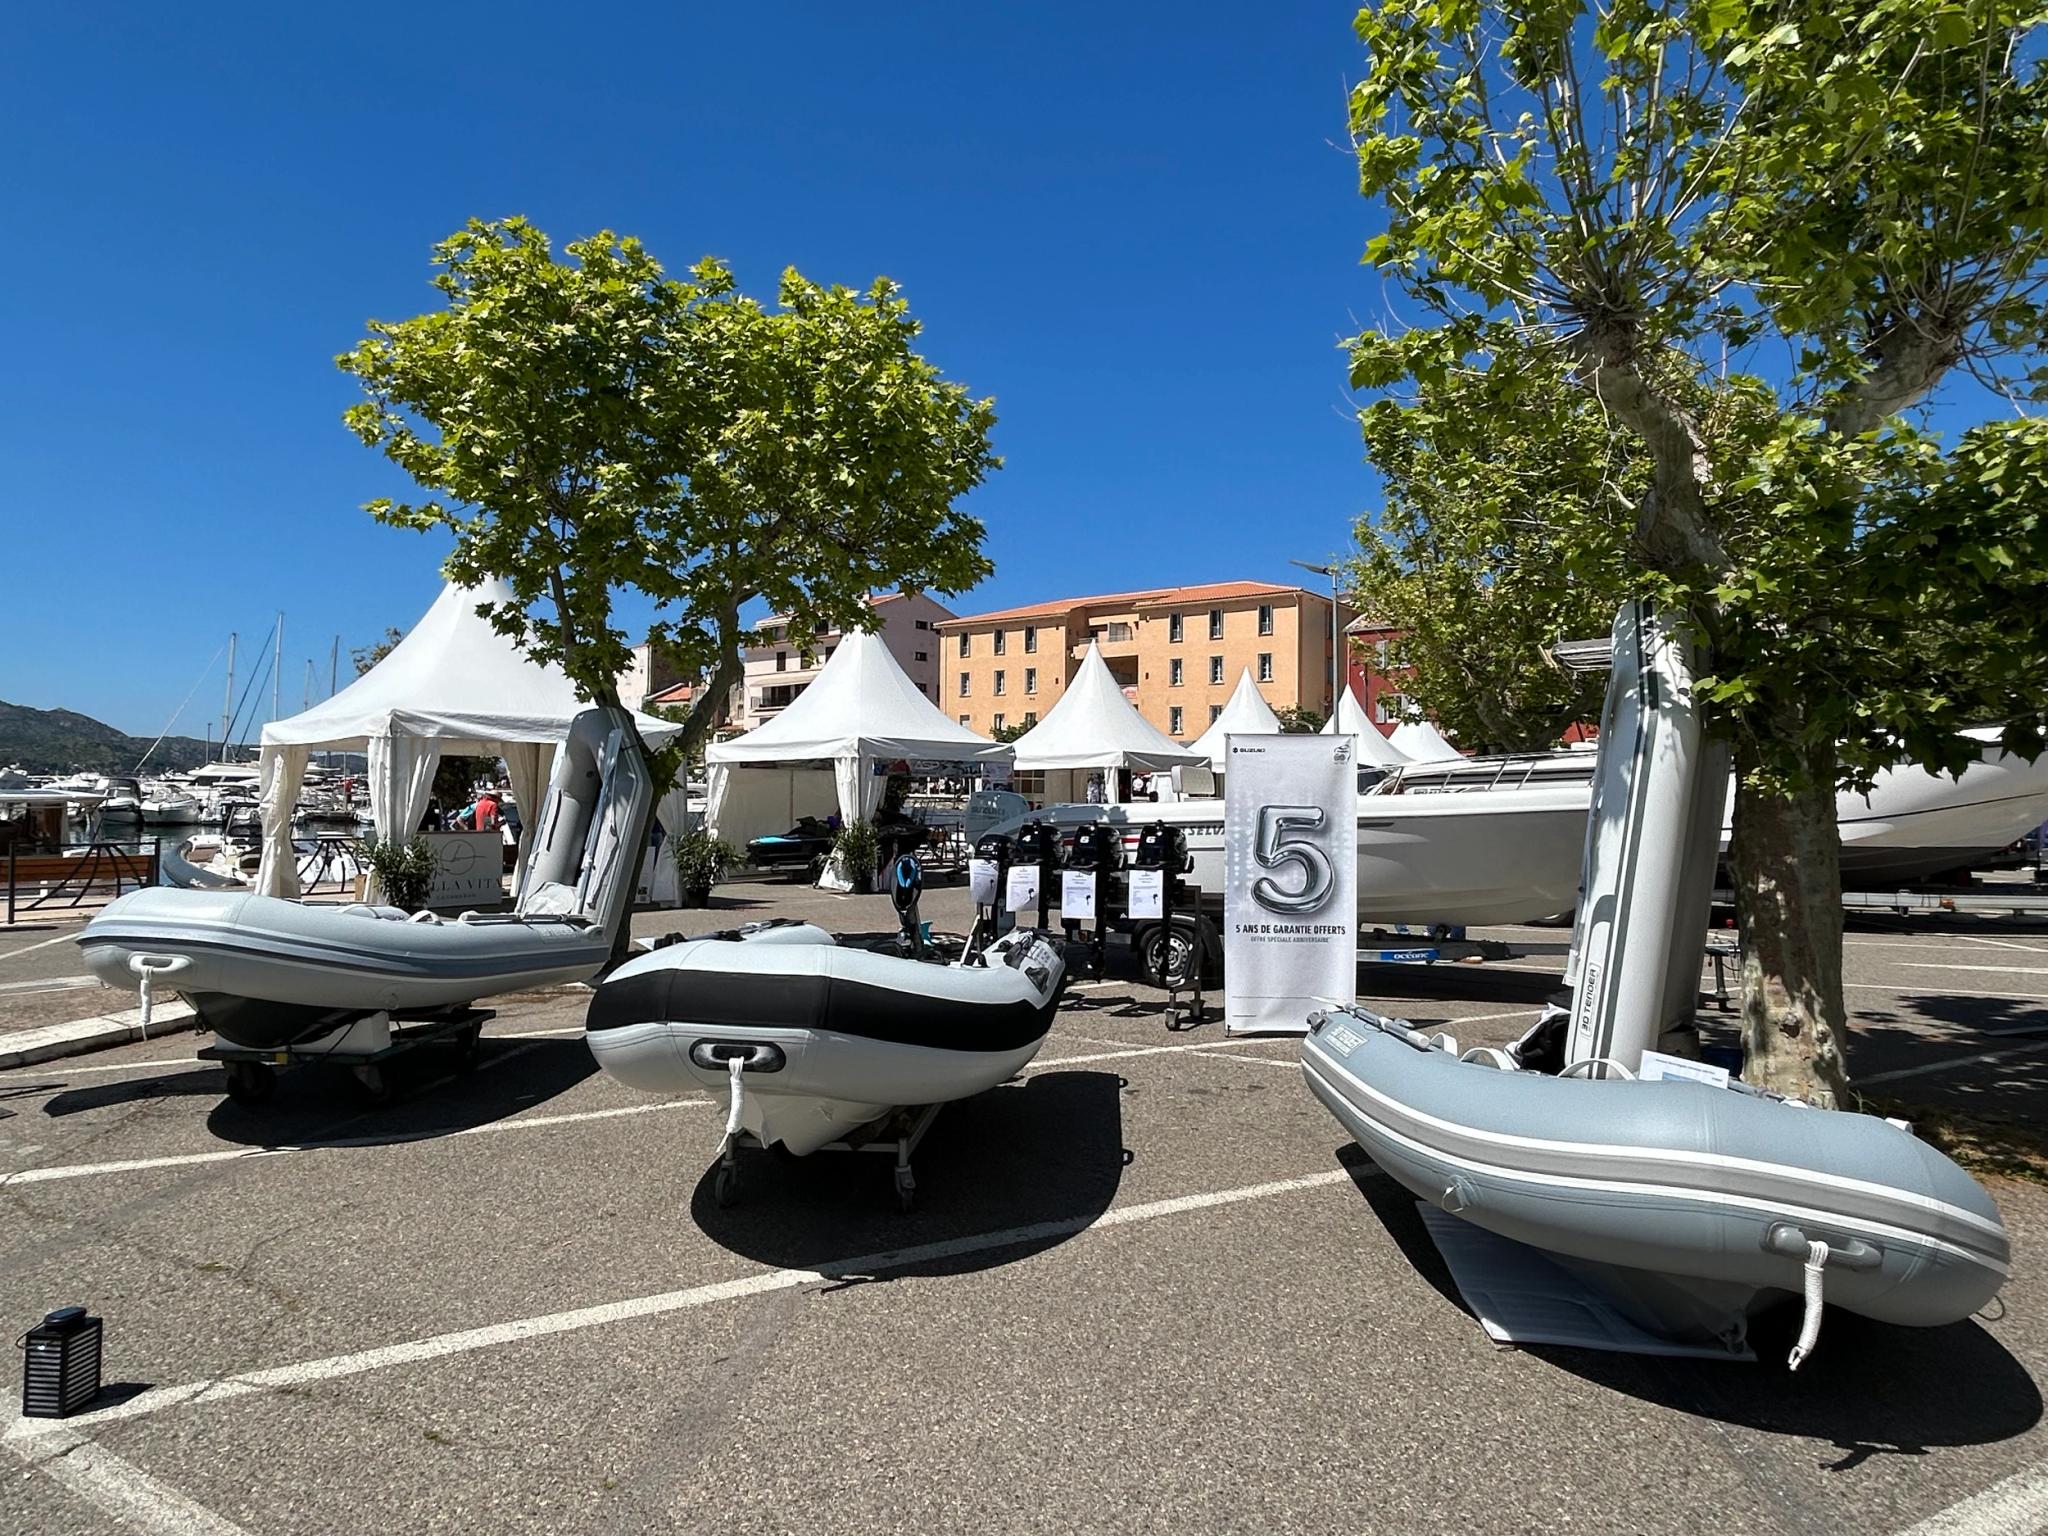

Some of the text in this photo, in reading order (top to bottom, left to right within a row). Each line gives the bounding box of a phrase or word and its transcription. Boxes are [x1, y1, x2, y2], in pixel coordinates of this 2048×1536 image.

[1079, 835, 1090, 844] 6
[1145, 835, 1156, 844] 6
[1251, 805, 1335, 914] 5
[1235, 924, 1346, 935] 5 ANS DE GARANTIE OFFERTS
